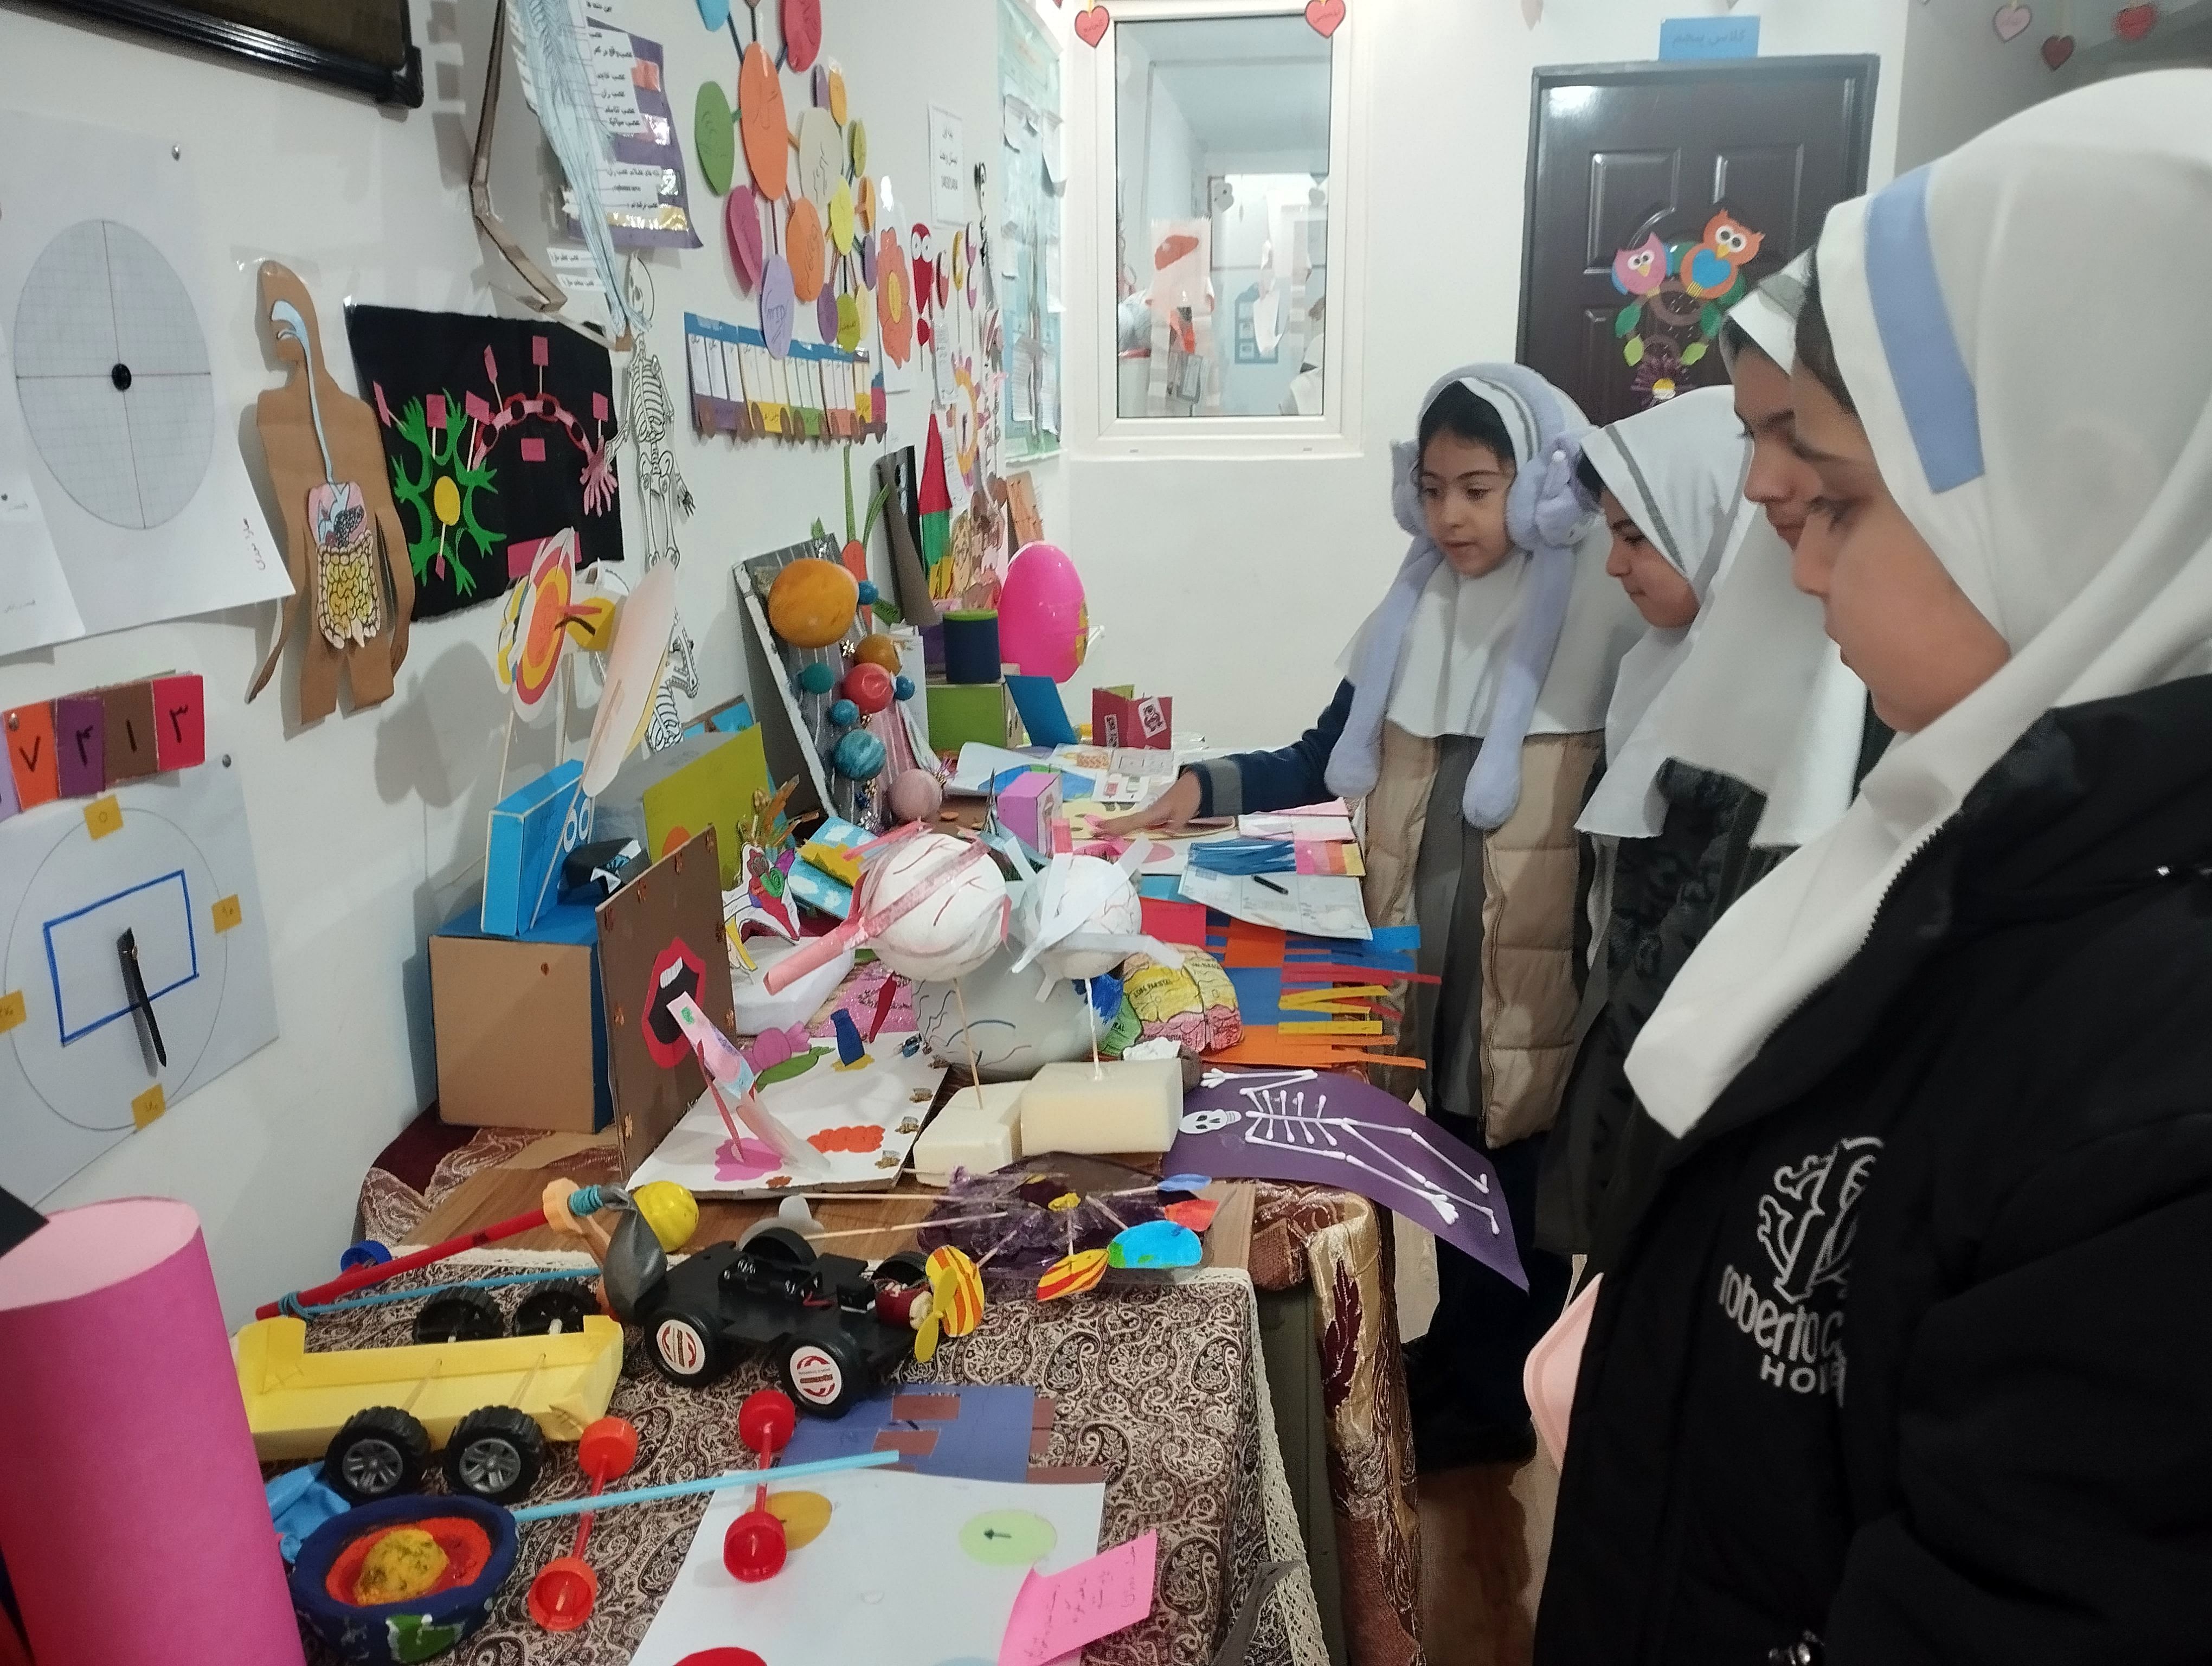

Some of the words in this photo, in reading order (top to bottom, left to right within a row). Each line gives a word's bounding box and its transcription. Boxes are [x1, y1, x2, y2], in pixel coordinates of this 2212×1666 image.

[19, 735, 41, 772] ۷
[126, 719, 137, 752] ۱
[169, 703, 189, 744] ۳
